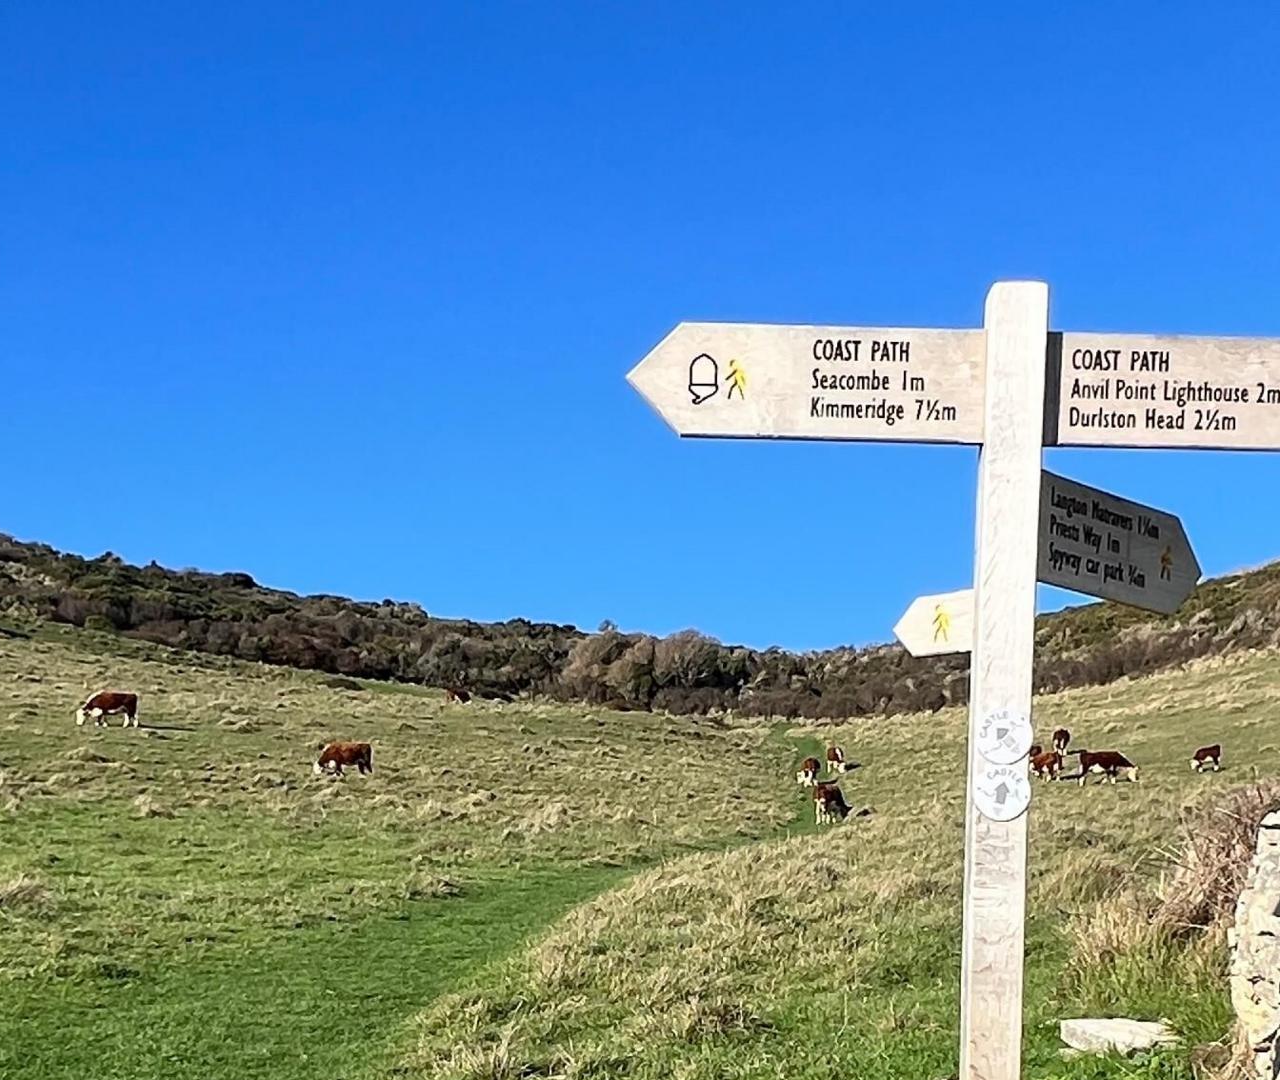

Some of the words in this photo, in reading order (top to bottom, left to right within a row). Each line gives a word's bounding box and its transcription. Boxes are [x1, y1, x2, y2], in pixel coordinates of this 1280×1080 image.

[812, 339, 862, 362] COAST
[870, 340, 911, 363] PATH
[1072, 348, 1122, 371] COAST
[1130, 350, 1170, 373] PATH
[811, 367, 890, 391] Seacombe
[1070, 378, 1110, 400] Anvil
[1115, 379, 1157, 401] Point
[1163, 380, 1249, 406] Lighthouse
[810, 396, 905, 426] Kimmeridge
[1069, 406, 1136, 429] Durlston
[1145, 408, 1185, 430] Head
[1051, 485, 1087, 518] Langton
[1050, 513, 1080, 542] Priests
[1083, 523, 1102, 554] Way
[1049, 542, 1081, 576] Spyway
[1085, 558, 1101, 575] car
[1103, 561, 1124, 584] park
